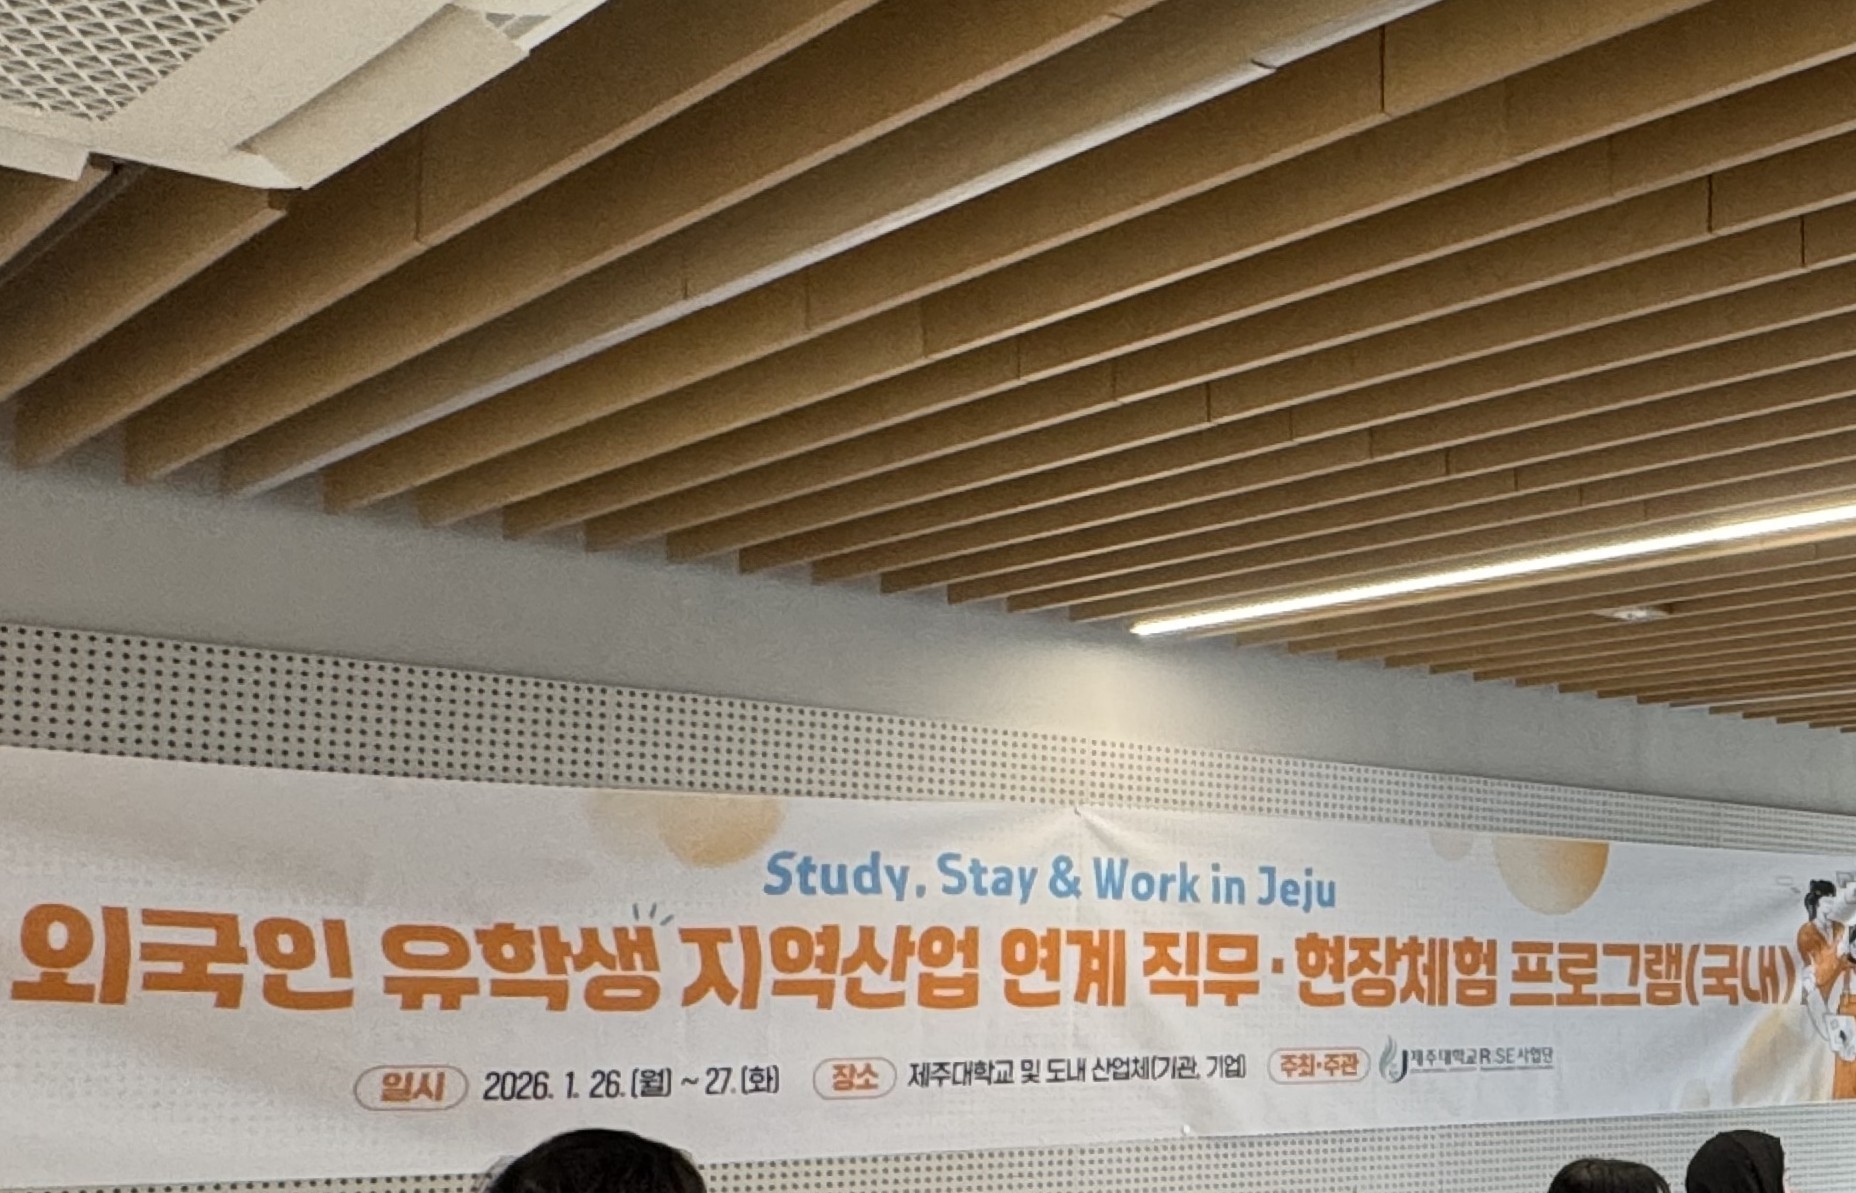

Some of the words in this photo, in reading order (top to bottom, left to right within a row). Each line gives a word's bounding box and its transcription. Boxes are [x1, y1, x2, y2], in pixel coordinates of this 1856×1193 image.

[763, 850, 926, 901] Study,
[937, 852, 1038, 905] Stay
[1049, 855, 1082, 899] &
[1094, 858, 1200, 903] Work
[1212, 863, 1245, 905] in
[1258, 866, 1335, 913] Jeju
[10, 904, 354, 1010] 외국인
[381, 922, 661, 1011] 유학생
[678, 924, 979, 1010] 지역산업
[1001, 928, 1126, 1007] 연계
[380, 1071, 446, 1102] 일시
[832, 1063, 879, 1092] 장소
[908, 1060, 1014, 1087] 제주대학교
[1021, 1059, 1040, 1083] 및
[1046, 1058, 1086, 1083] 도내
